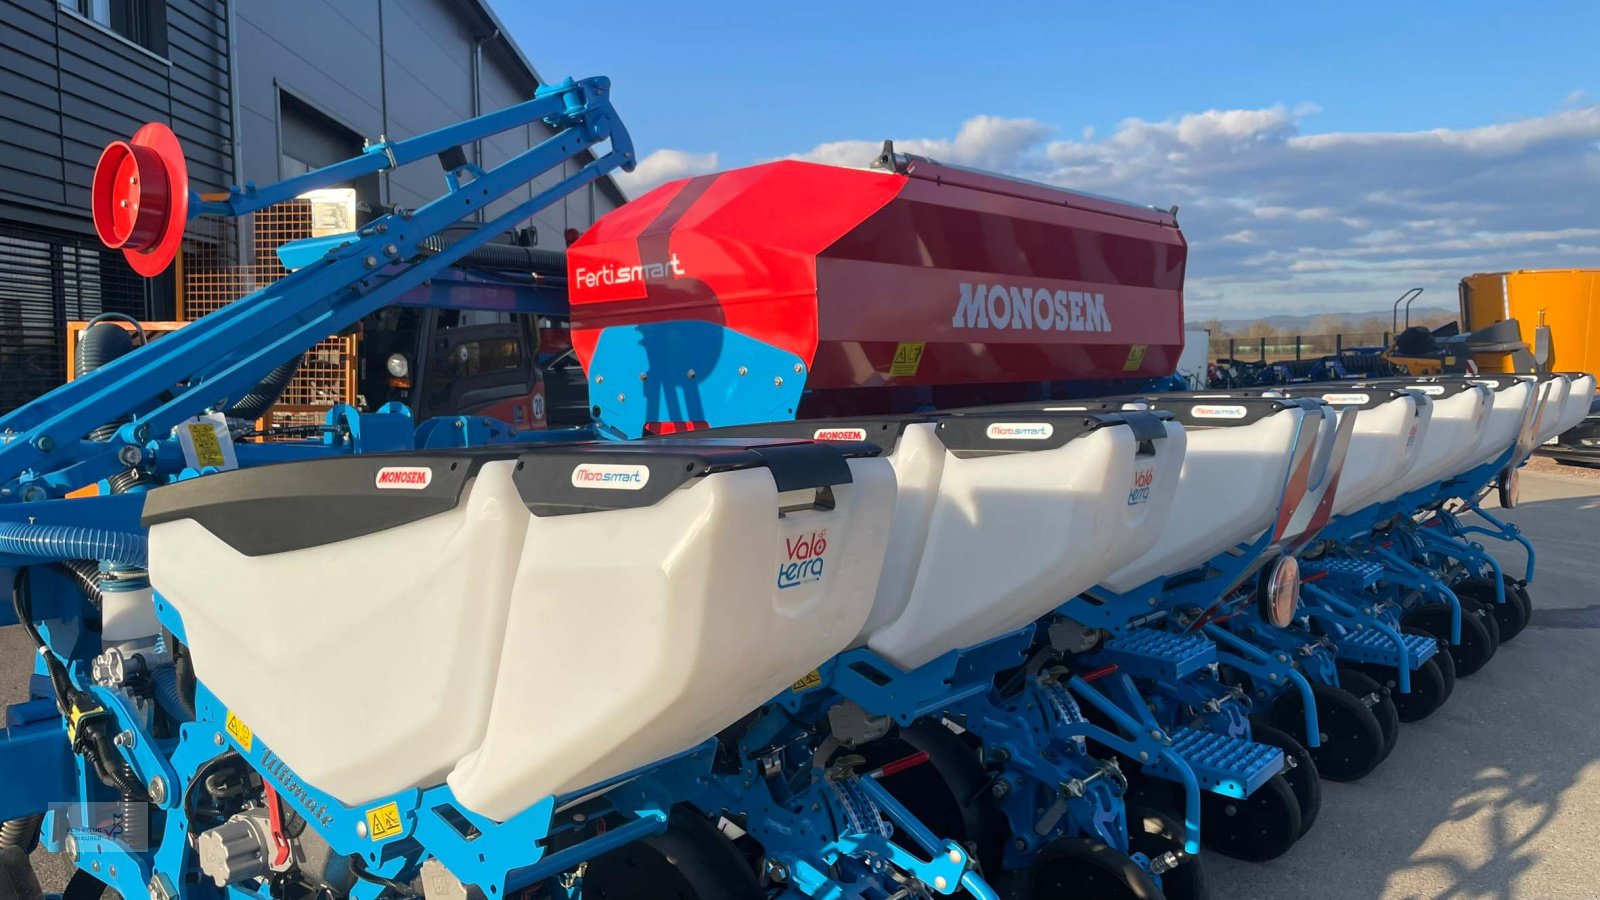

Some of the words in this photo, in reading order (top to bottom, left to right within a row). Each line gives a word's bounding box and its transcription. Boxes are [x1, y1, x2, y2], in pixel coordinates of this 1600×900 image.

[952, 283, 1113, 332] MONOSEM
[535, 398, 543, 416] 20
[817, 431, 862, 440] MONOSEM
[378, 471, 426, 484] MONOSEM
[777, 557, 823, 589] terra
[261, 747, 334, 829] Ultimate
